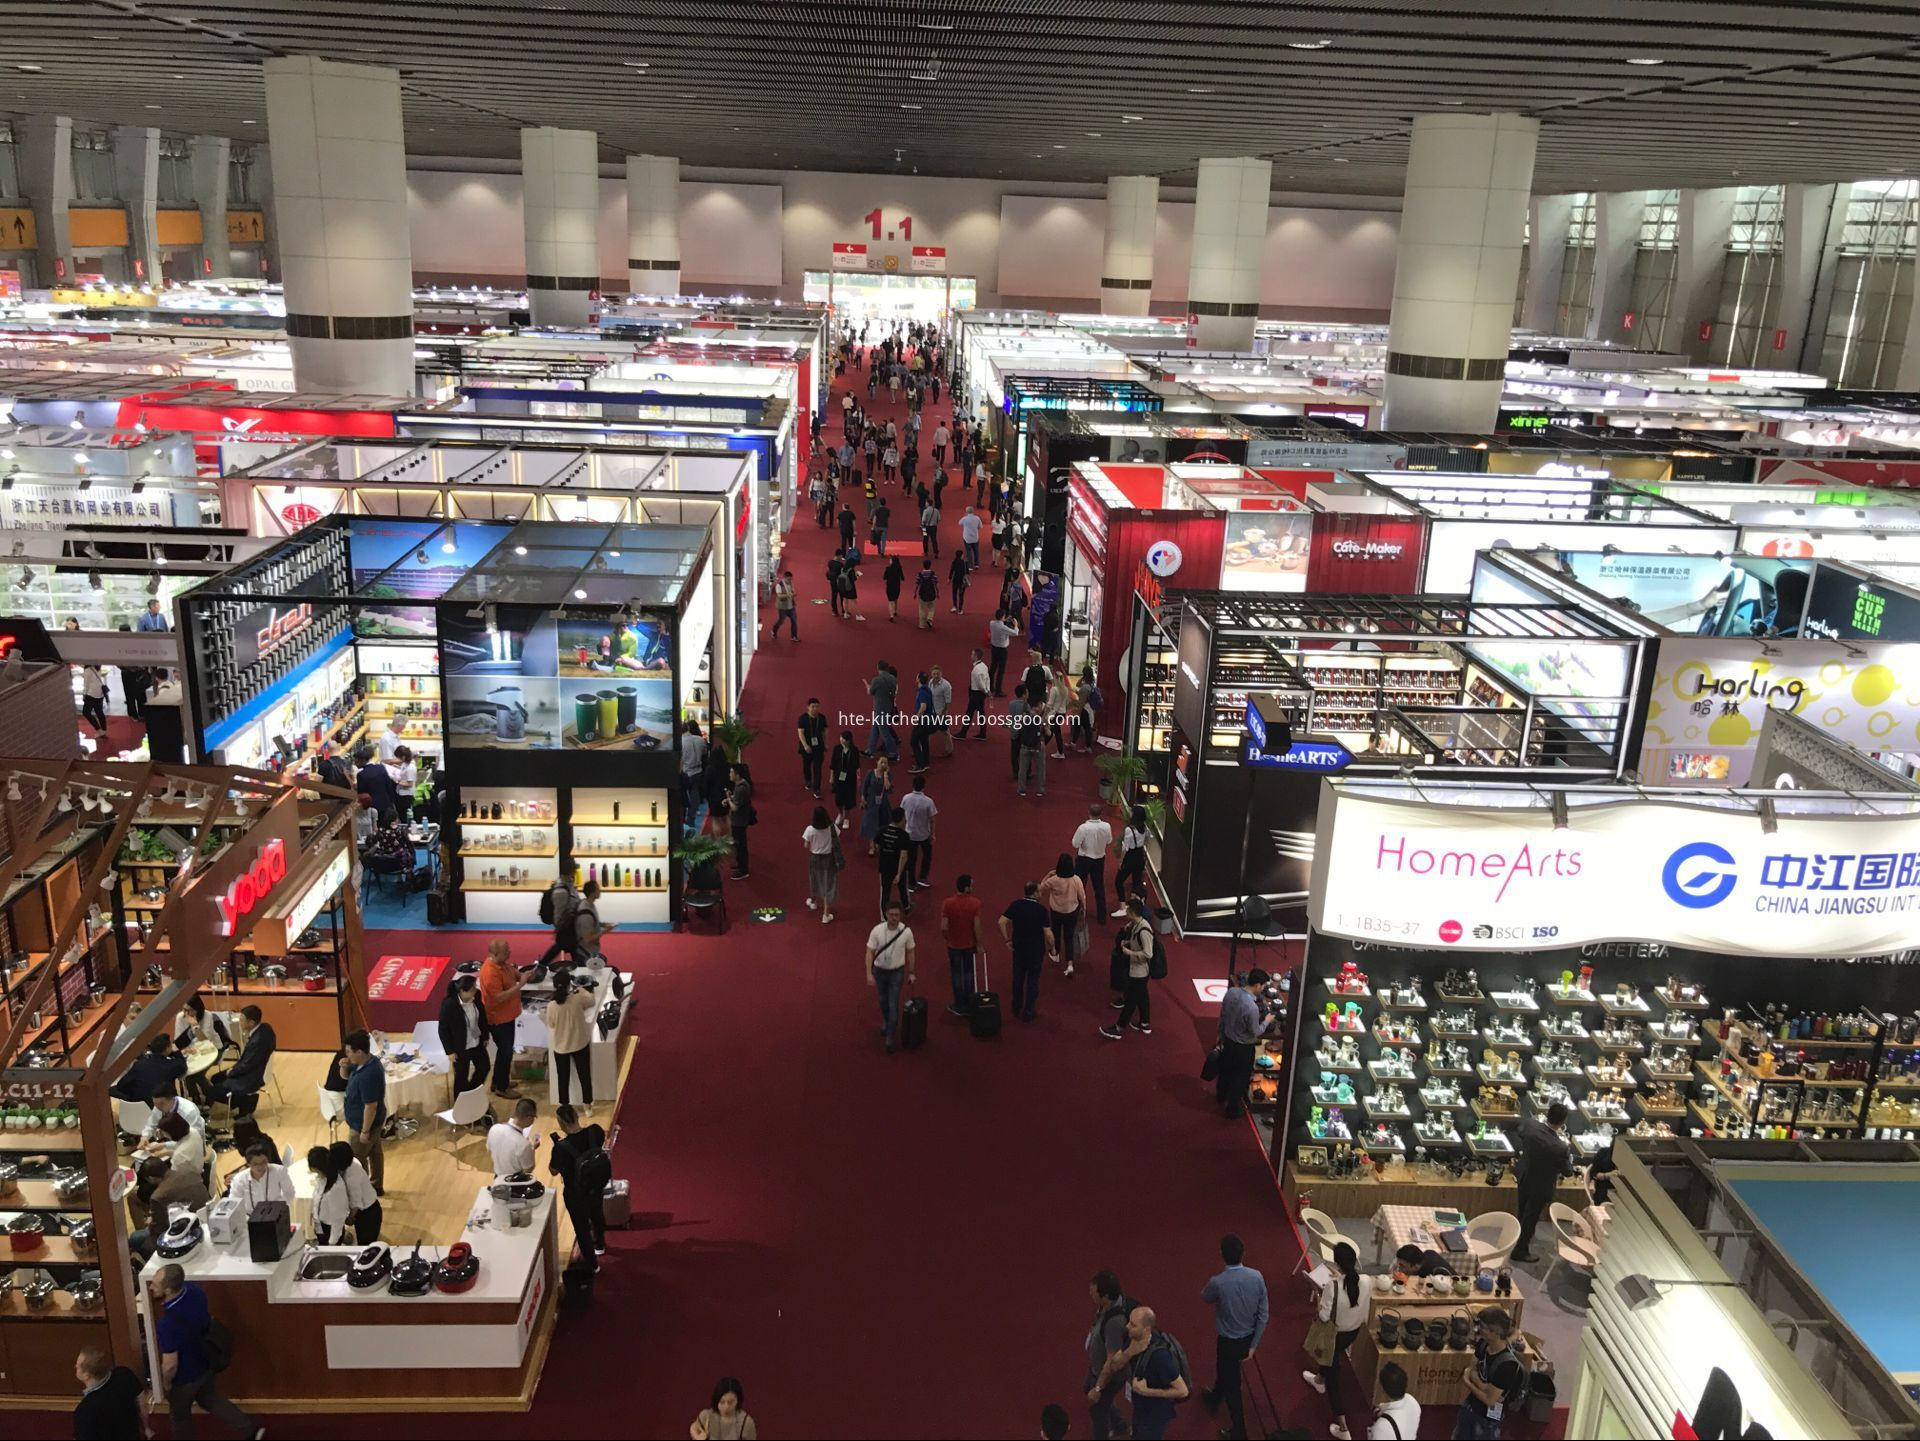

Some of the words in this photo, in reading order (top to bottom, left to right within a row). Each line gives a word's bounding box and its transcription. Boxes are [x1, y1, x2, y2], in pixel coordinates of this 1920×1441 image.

[865, 208, 912, 241] 1.1
[1624, 315, 1632, 329] K
[1703, 325, 1710, 338] J
[246, 379, 278, 390] OPAL
[1858, 590, 1886, 605] MAKING
[1855, 598, 1883, 617] CUP
[1854, 611, 1881, 629] WITH
[1696, 669, 1806, 712] Harling
[1693, 699, 1740, 716] 哈林
[1377, 834, 1582, 903] HomeArts
[1755, 895, 1809, 914] CHINA
[1814, 896, 1888, 915] JIANGSU
[1495, 926, 1525, 939] BSCI
[1532, 925, 1559, 938] ISO
[1582, 942, 1669, 958] CAFETERA
[368, 957, 405, 998] BRAND
